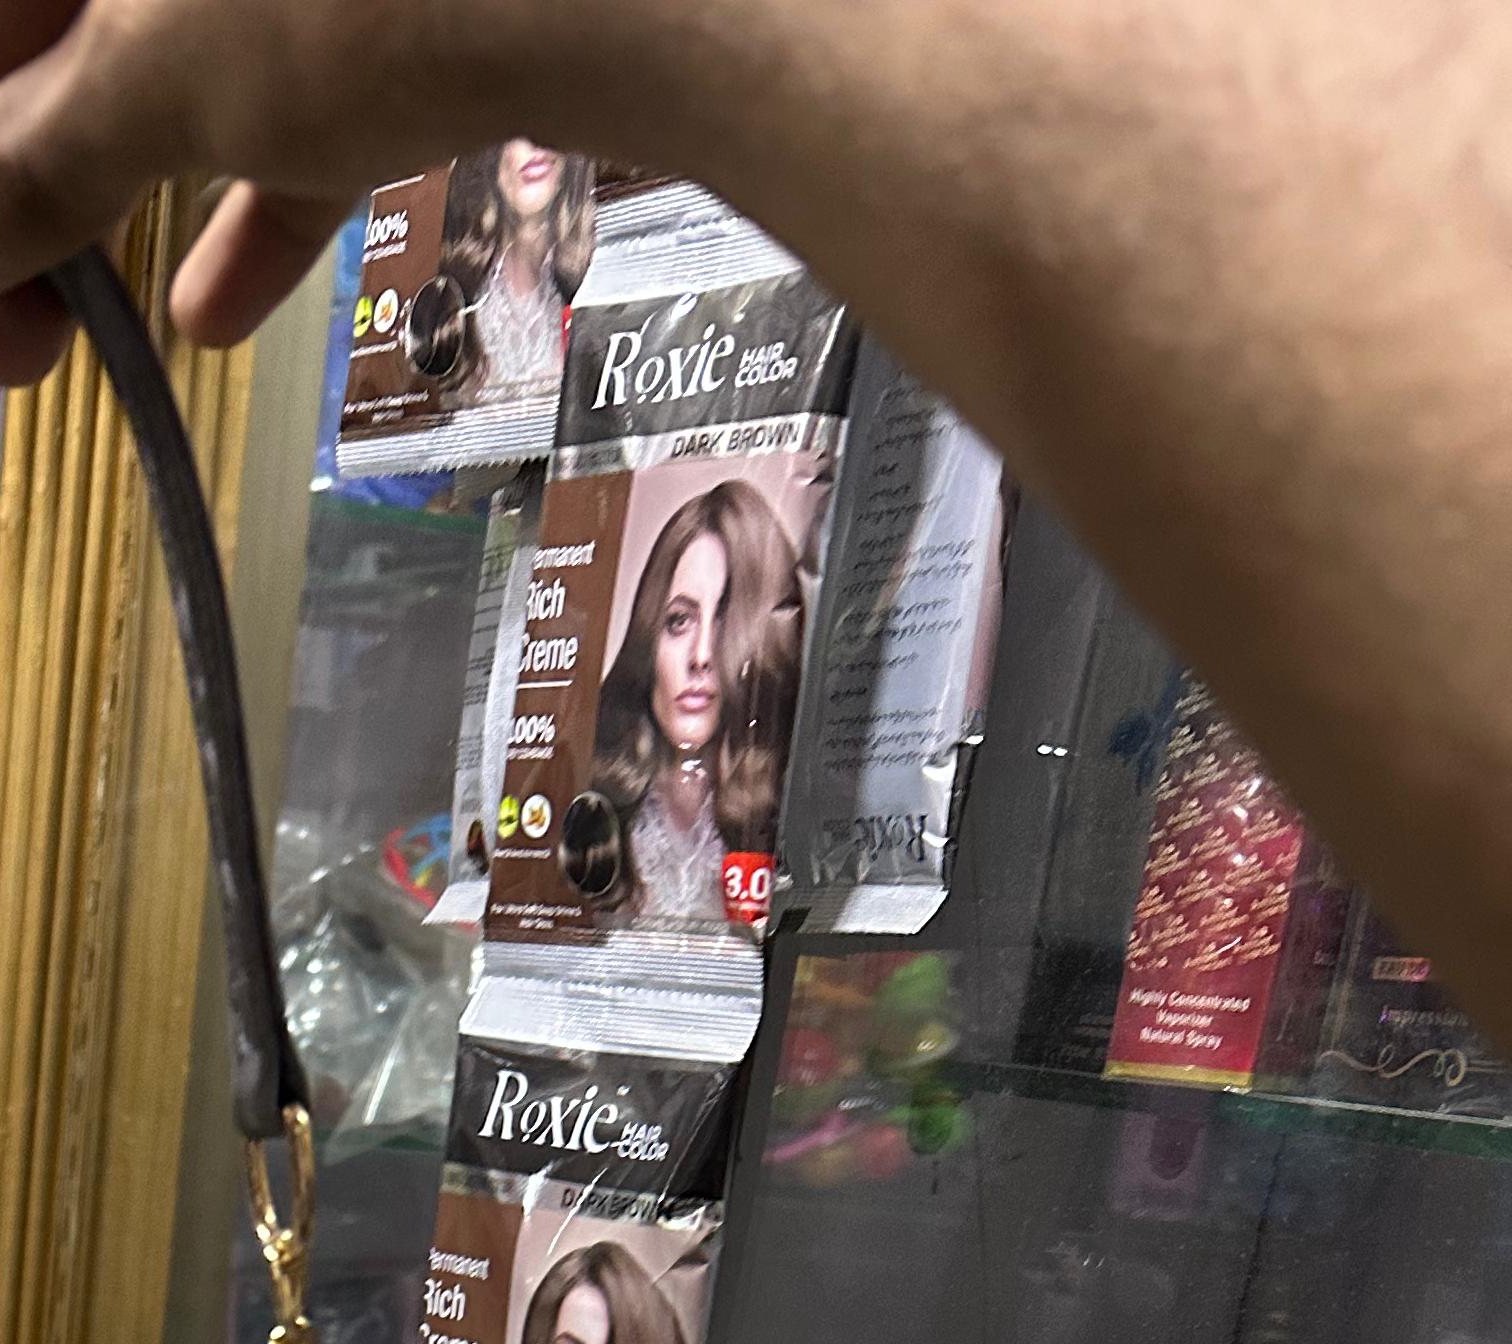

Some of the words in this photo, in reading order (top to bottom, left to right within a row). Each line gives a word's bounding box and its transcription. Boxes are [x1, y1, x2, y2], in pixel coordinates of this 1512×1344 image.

[591, 318, 735, 411] Roxie
[738, 341, 786, 370] HAIR
[734, 356, 799, 389] COLOR
[671, 427, 723, 459] DARK
[726, 419, 801, 453] BROWN
[533, 539, 597, 571] ermanent
[723, 864, 772, 902] 3.0
[1128, 986, 1168, 1010] Highly
[1168, 990, 1252, 1014] Concentrated
[1155, 1008, 1215, 1029] Vaporizer
[1139, 1026, 1186, 1045] Natural
[1186, 1029, 1224, 1052] Spray
[476, 1069, 619, 1154] Roxie
[621, 1121, 663, 1143] HAIR
[615, 1140, 671, 1163] COLOR
